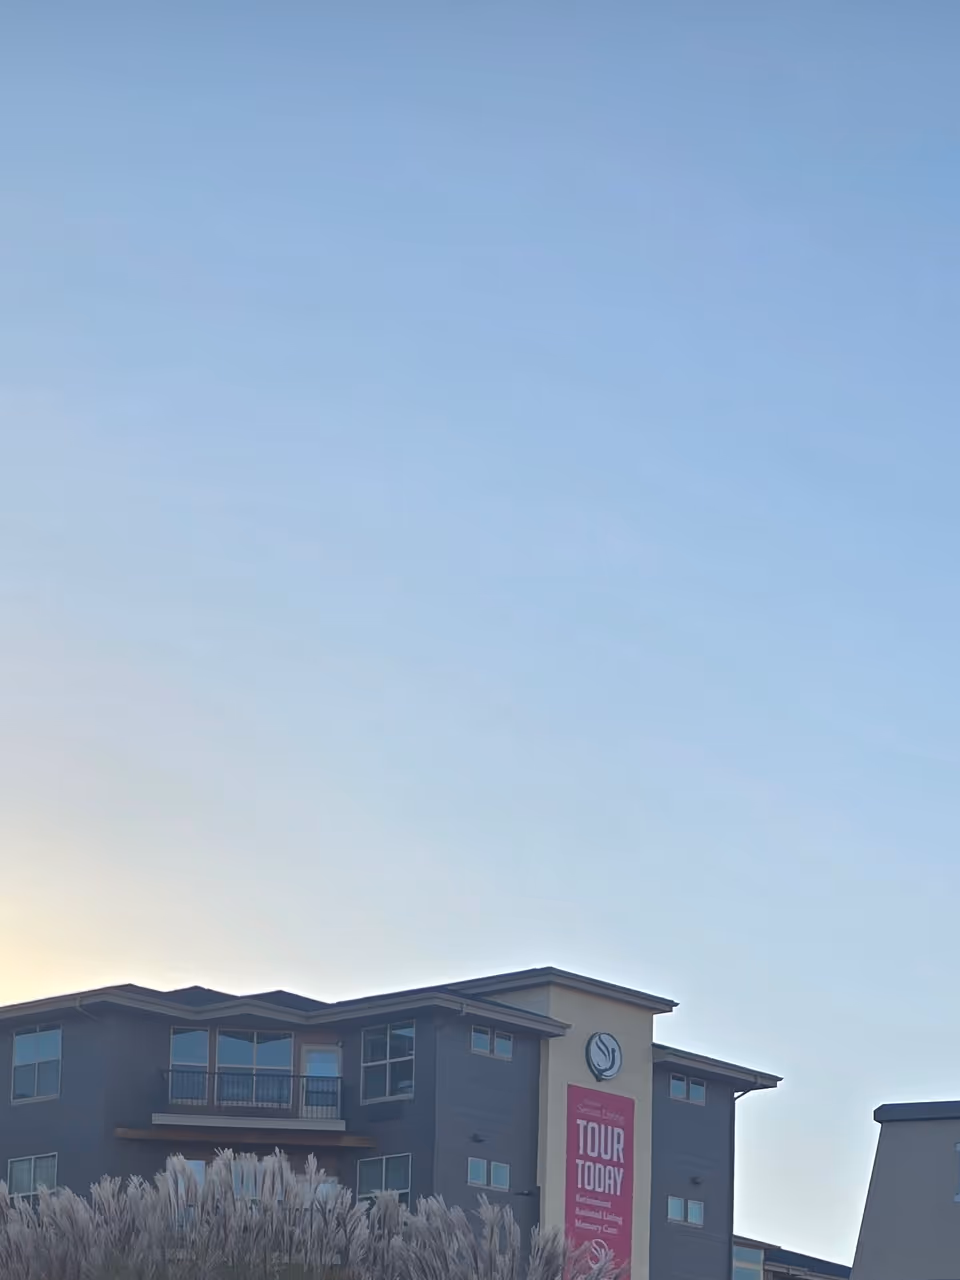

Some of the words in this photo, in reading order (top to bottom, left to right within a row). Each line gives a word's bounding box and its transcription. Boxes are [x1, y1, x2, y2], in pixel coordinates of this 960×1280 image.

[576, 1118, 624, 1164] TOUR
[575, 1158, 624, 1196] TODAY
[575, 1218, 602, 1233] Memory
